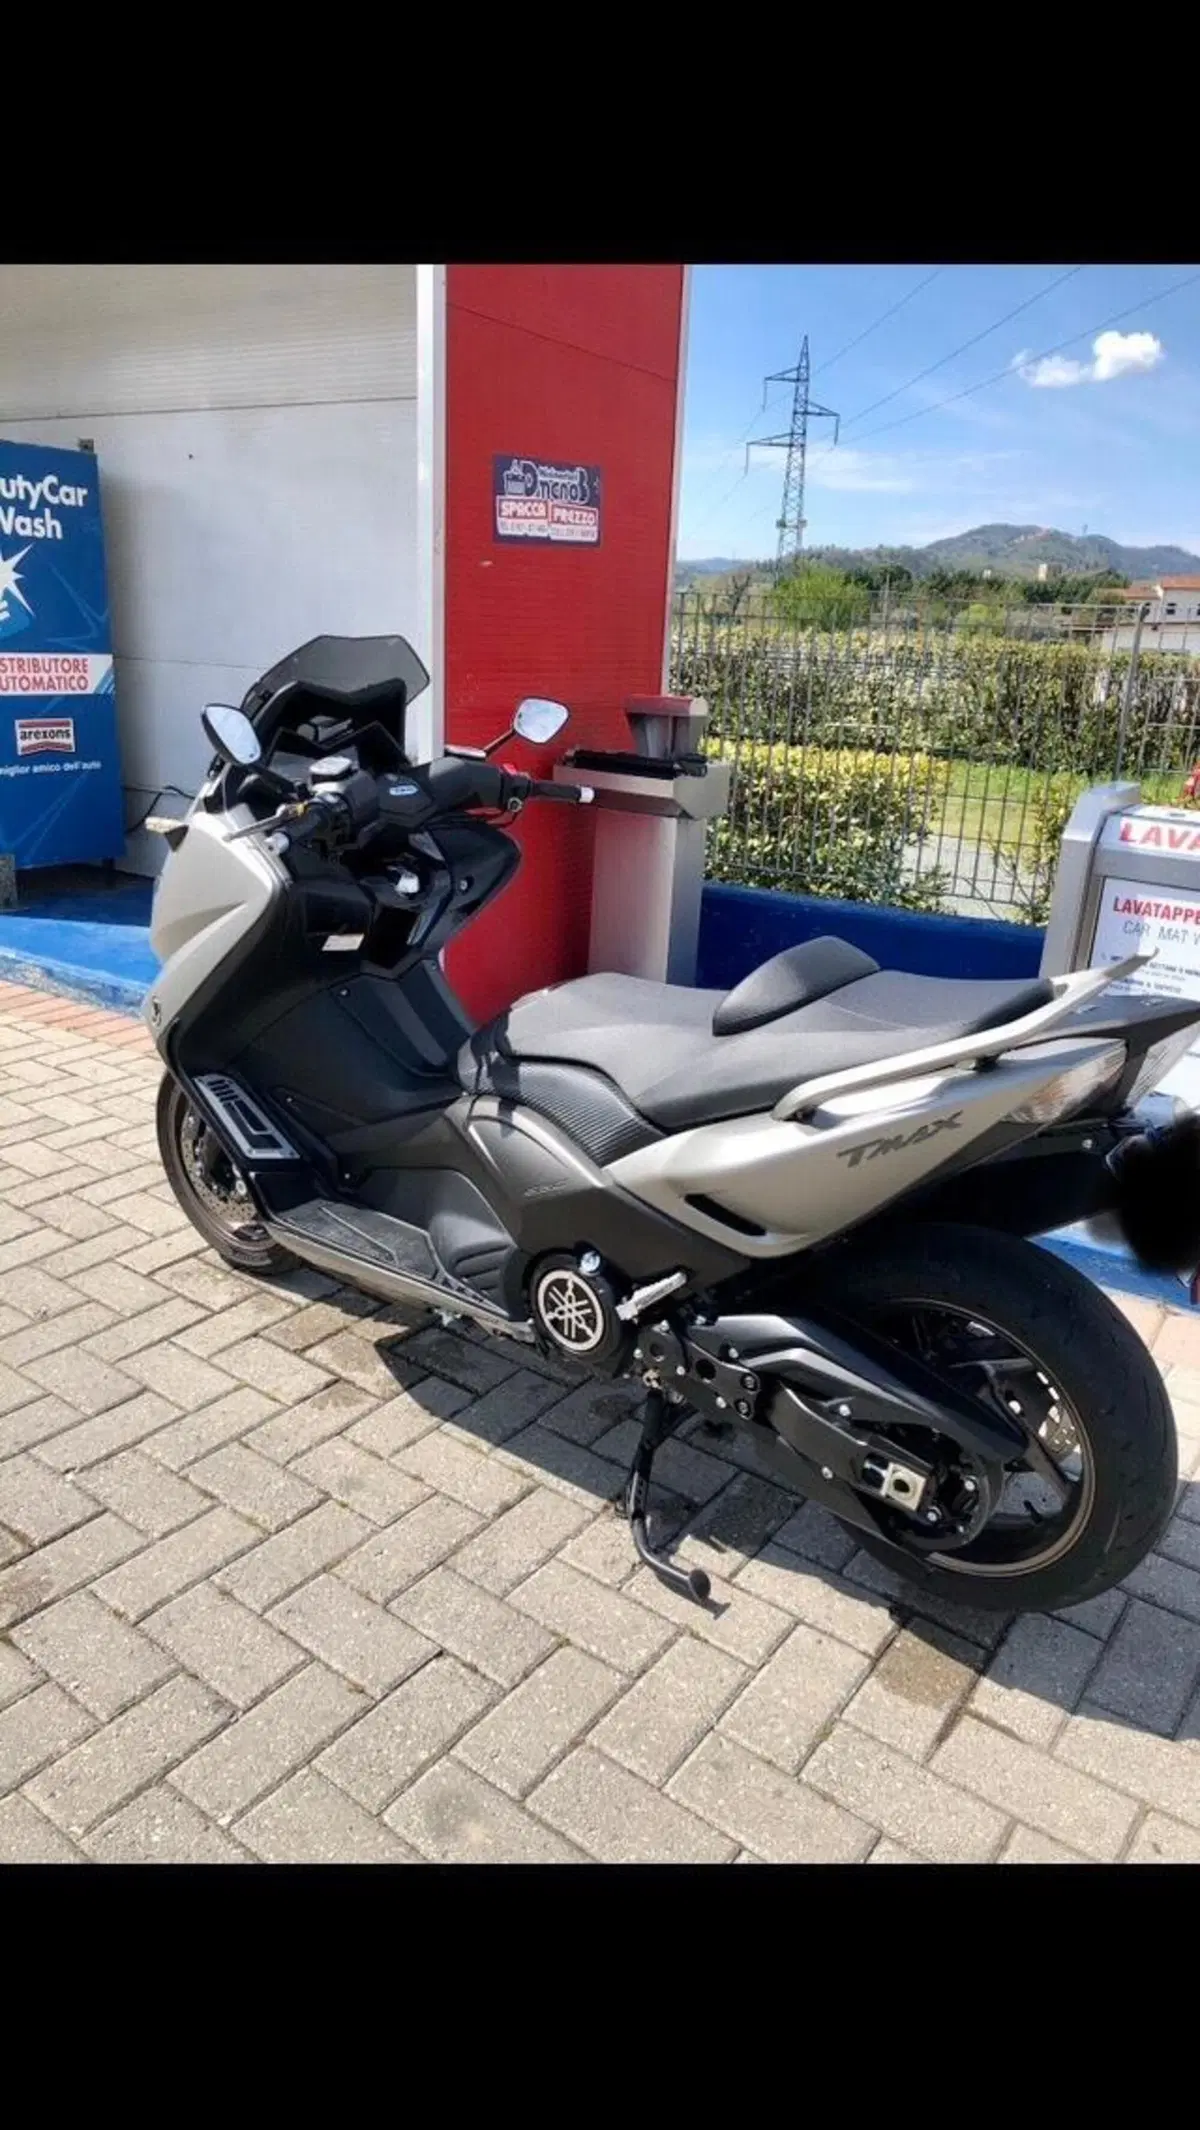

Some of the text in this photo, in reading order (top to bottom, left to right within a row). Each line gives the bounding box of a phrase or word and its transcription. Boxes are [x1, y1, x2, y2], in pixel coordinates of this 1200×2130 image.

[500, 502, 547, 517] SPACCA
[0, 657, 88, 674] STRIBUTORE
[0, 675, 88, 692] UTOMATICO
[20, 729, 71, 740] arexons
[1123, 920, 1150, 937] CAR
[1157, 926, 1189, 944] MAT
[836, 1109, 963, 1168] TMAX
